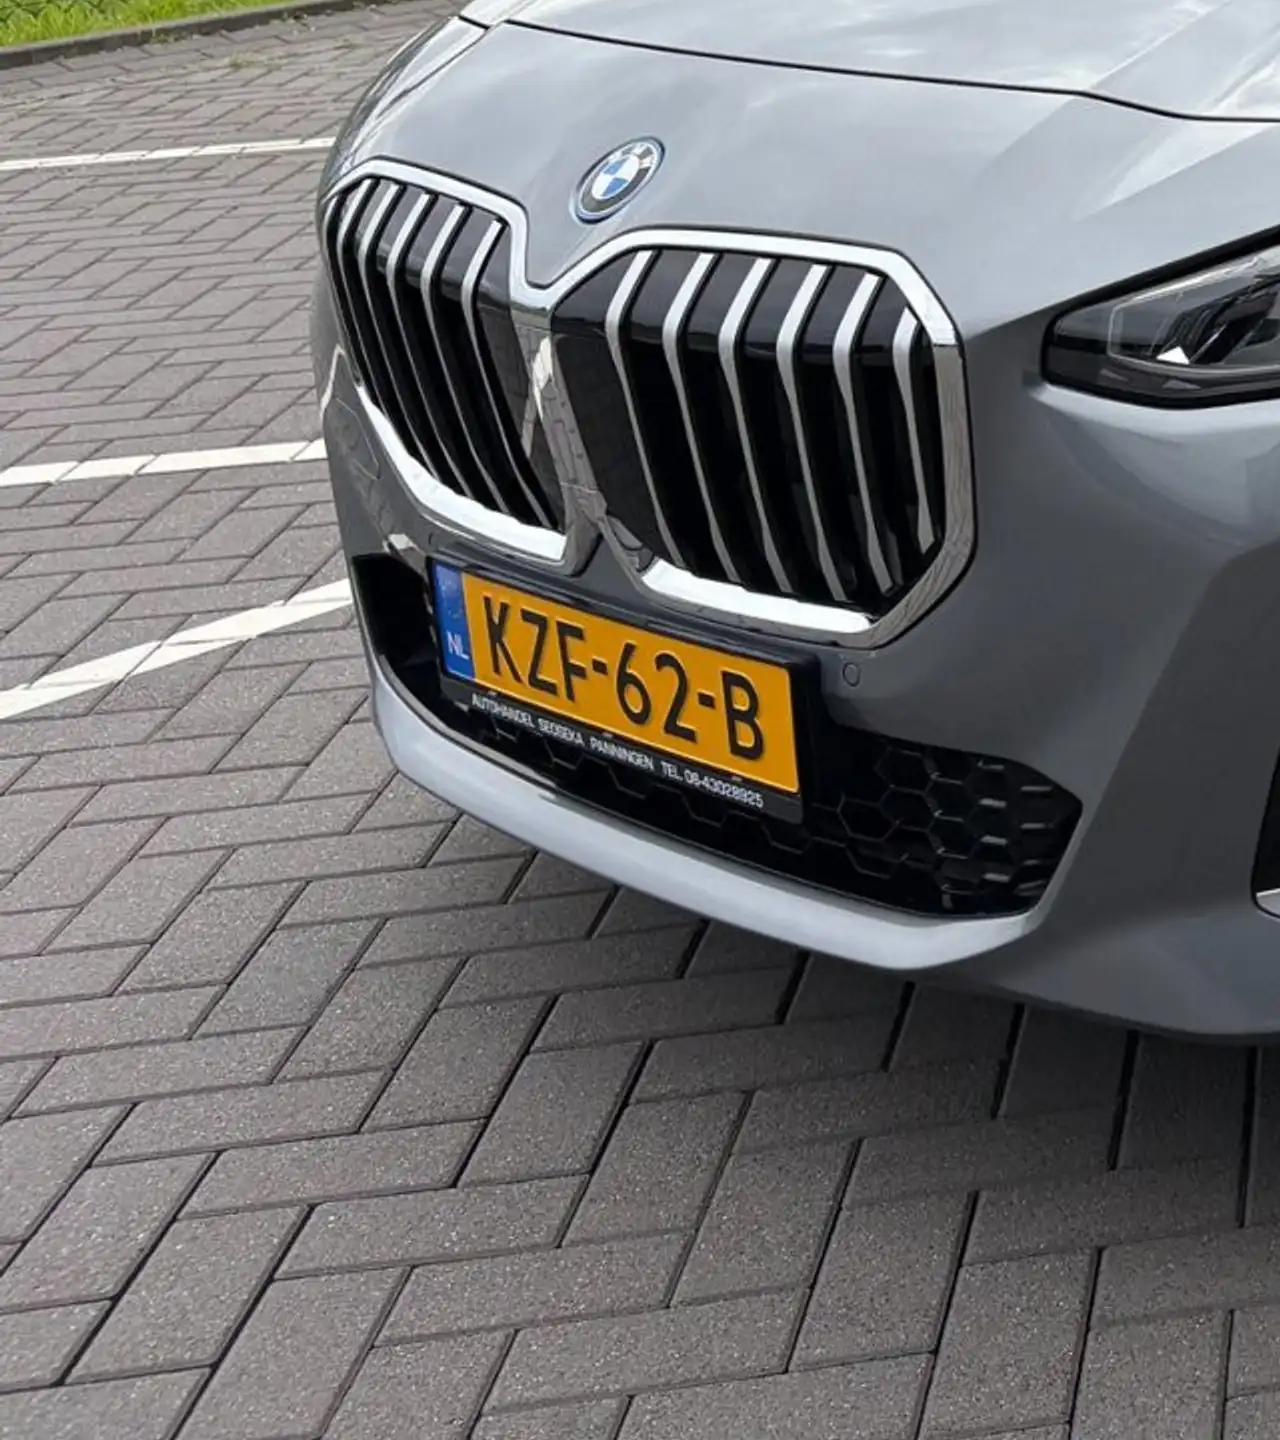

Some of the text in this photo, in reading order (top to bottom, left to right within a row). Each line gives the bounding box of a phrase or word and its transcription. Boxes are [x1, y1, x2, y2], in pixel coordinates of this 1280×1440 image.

[446, 630, 470, 660] NL
[483, 595, 764, 761] KZF-62-B
[471, 692, 536, 729] AUTOHANDEL
[589, 735, 655, 772] PANNINGEN
